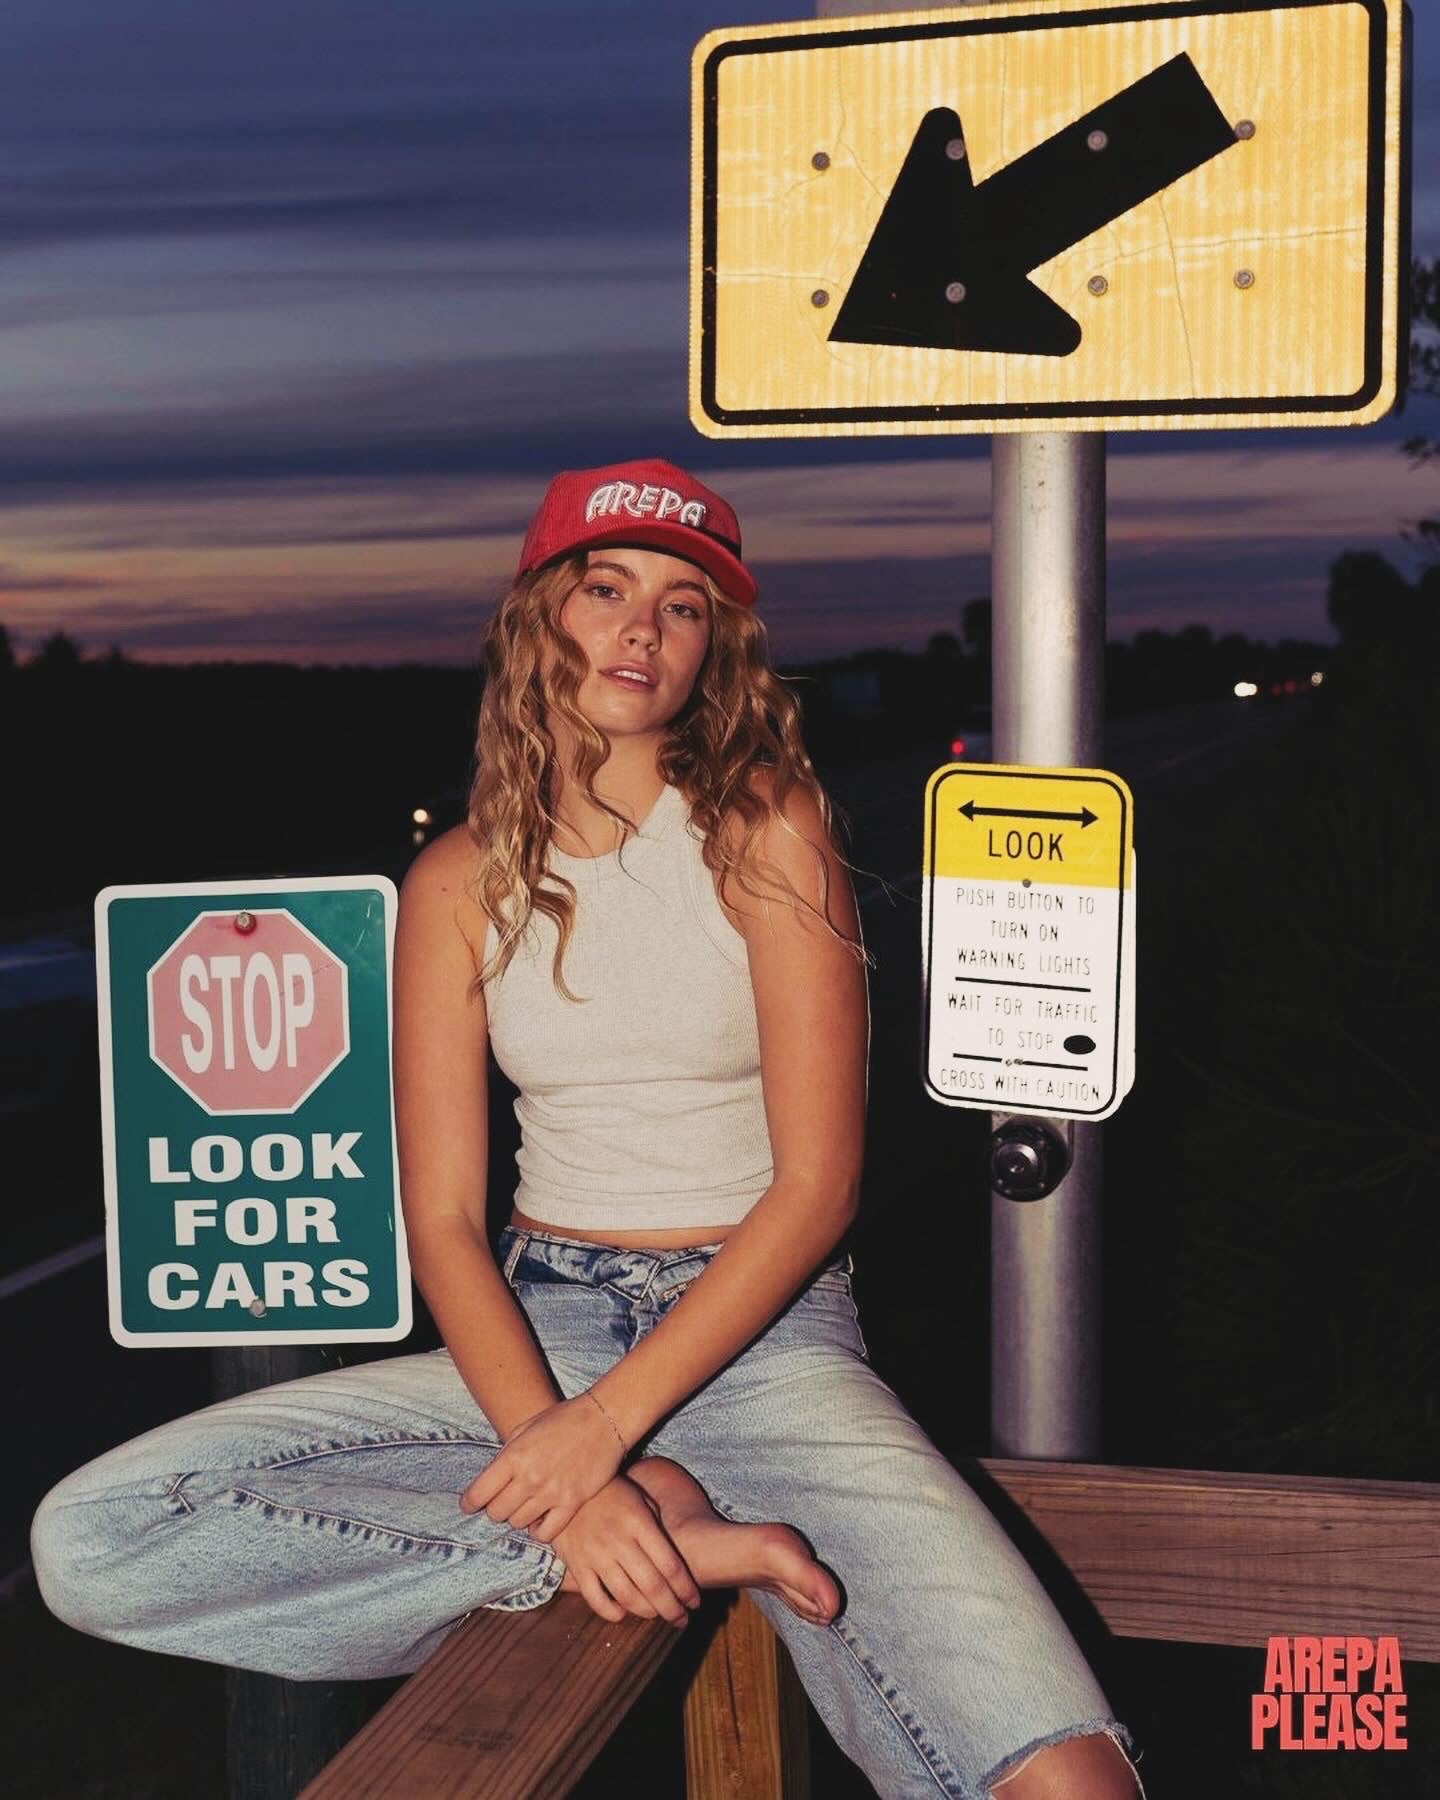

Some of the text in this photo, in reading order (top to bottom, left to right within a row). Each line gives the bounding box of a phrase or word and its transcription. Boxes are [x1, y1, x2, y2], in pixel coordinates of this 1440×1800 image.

[585, 480, 707, 528] AREPA
[988, 829, 1064, 862] LOOK
[956, 887, 1095, 915] PUSH BUTTON TO
[991, 920, 1059, 942] TURN ON
[957, 948, 1091, 976] WARNING LIGHTS
[179, 951, 315, 1074] STOP
[947, 992, 1098, 1024] WAIT FOR TRAFFIC
[988, 1027, 1054, 1052] TO STOP
[940, 1068, 1101, 1103] CROSS WITH CAUTION
[148, 1132, 365, 1183] LOOK
[174, 1197, 341, 1246] FOR
[147, 1259, 370, 1311] CARS
